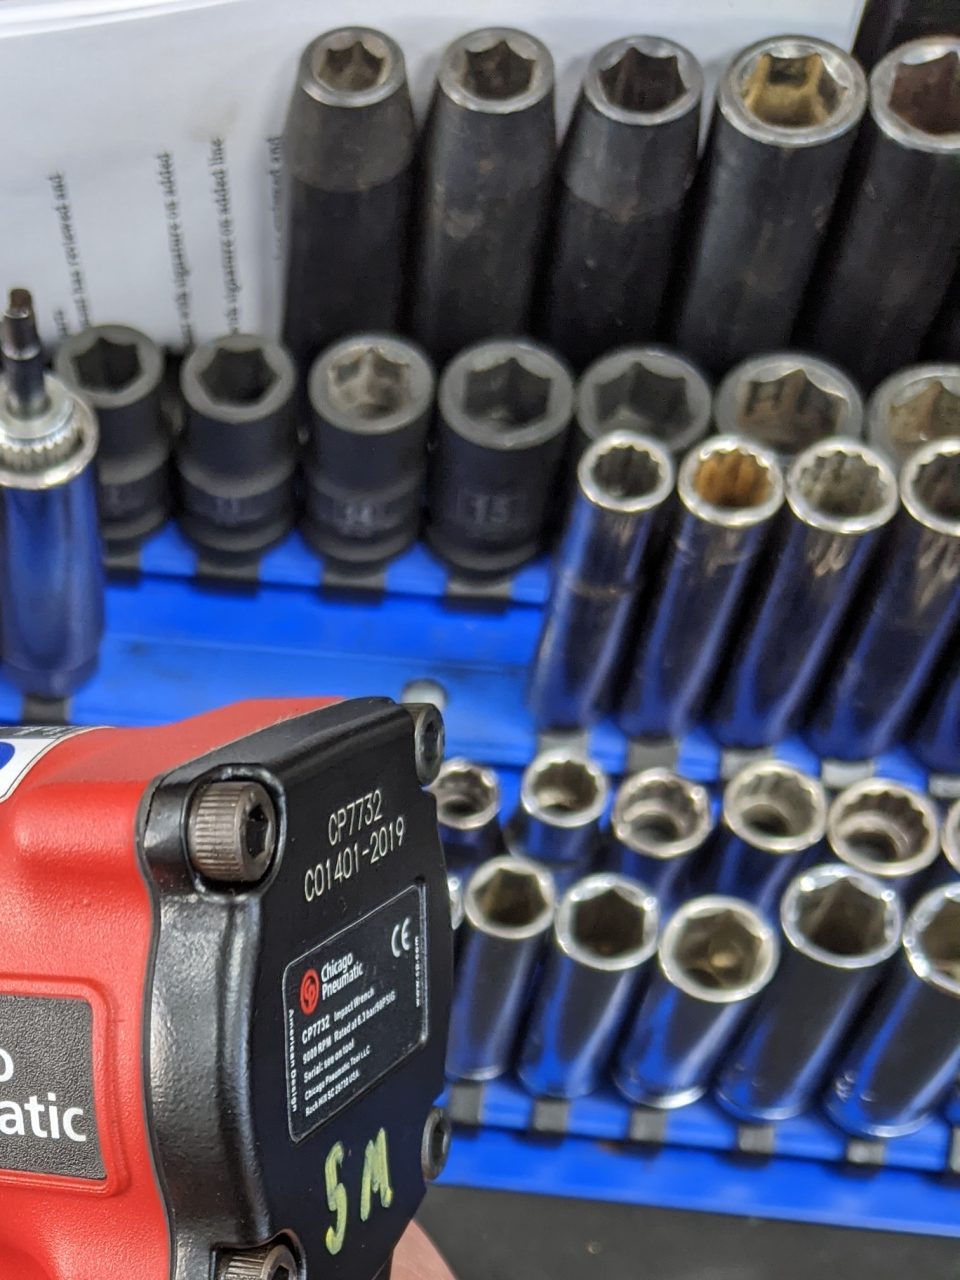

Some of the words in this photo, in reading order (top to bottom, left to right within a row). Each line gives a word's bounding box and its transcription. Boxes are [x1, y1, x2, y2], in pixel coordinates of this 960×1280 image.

[209, 137, 223, 166] line
[157, 152, 176, 196] added
[211, 168, 229, 215] added
[328, 789, 383, 846] CP7732
[321, 952, 354, 982] Chicago
[322, 961, 364, 1000] Pneumatic
[302, 1014, 330, 1044] CP7732
[334, 1001, 354, 1022] Impact
[318, 1035, 332, 1054] RPM
